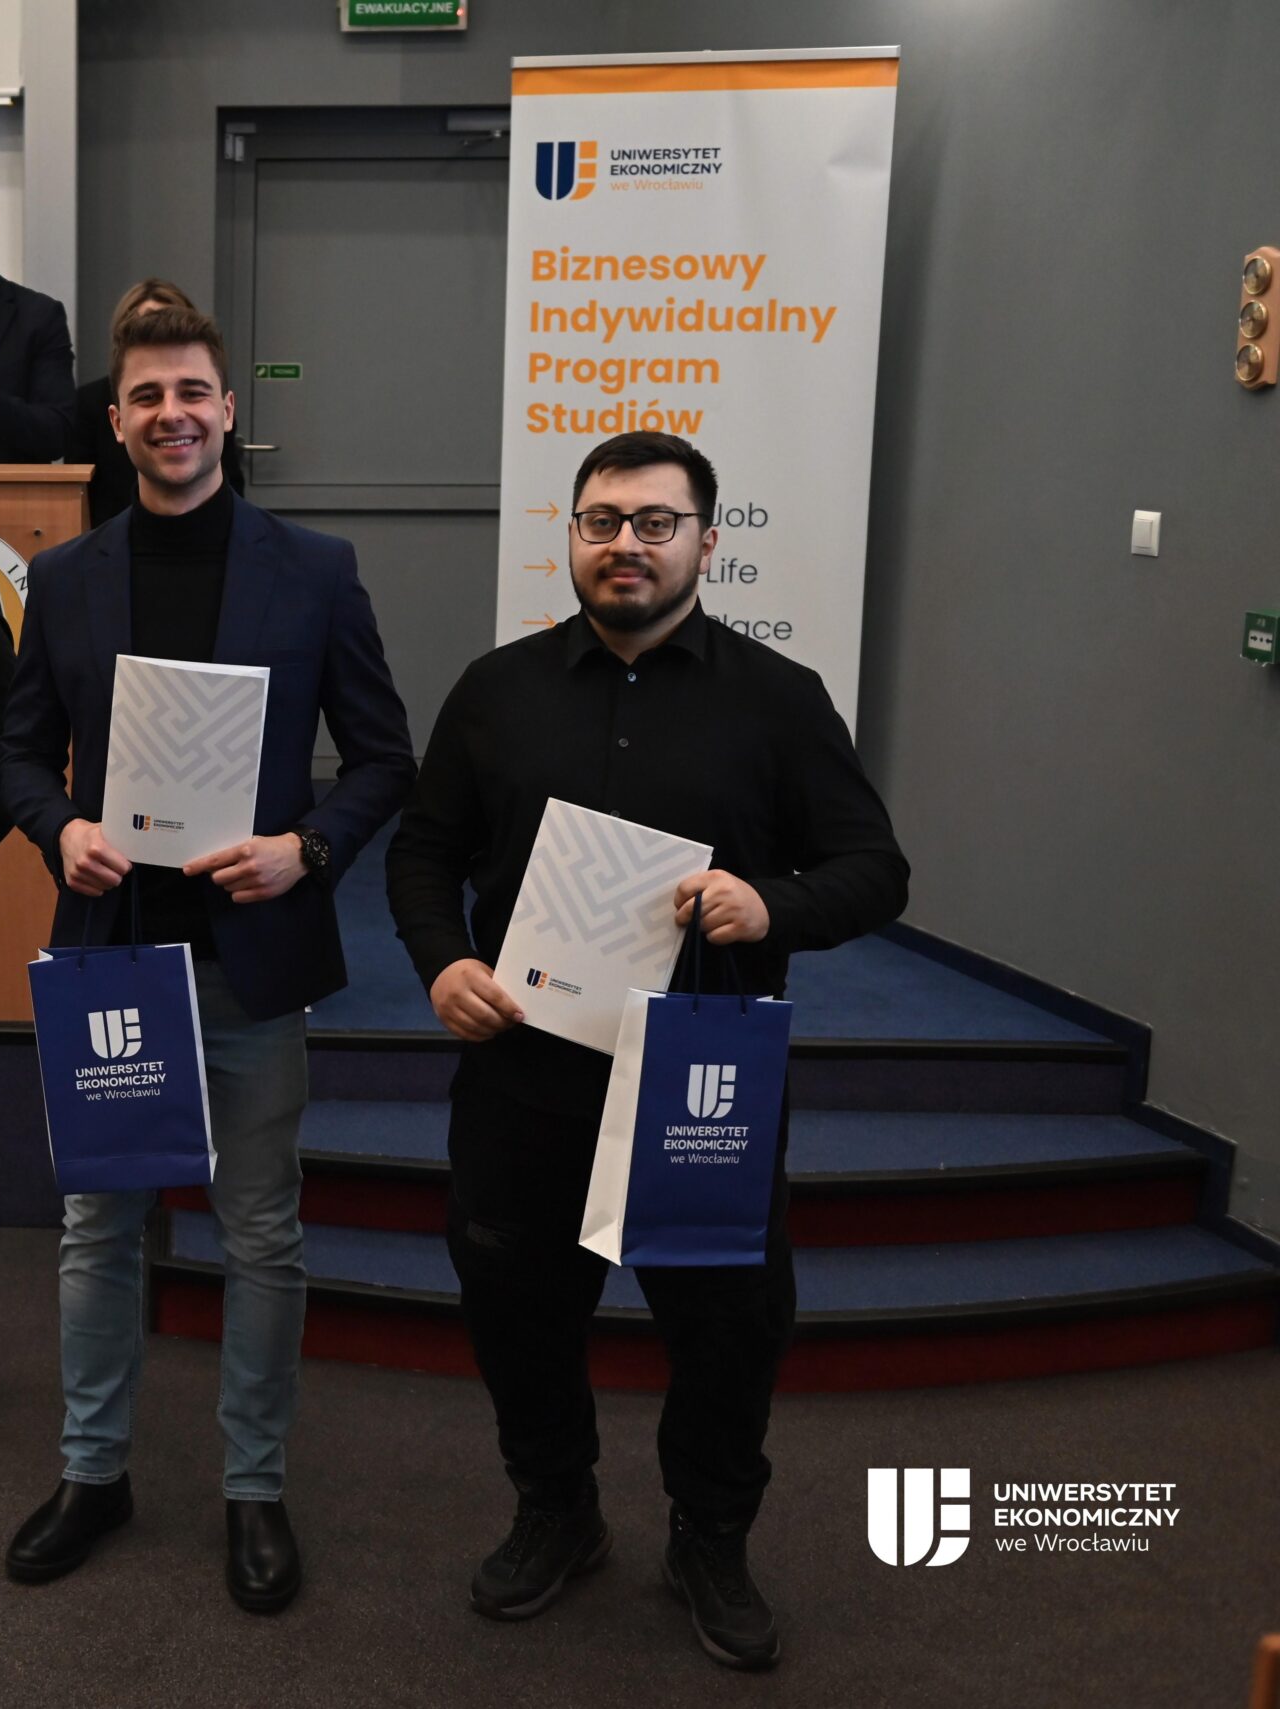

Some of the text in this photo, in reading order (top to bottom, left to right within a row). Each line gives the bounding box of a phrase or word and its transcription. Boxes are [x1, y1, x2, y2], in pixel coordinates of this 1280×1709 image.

[354, 2, 454, 15] EWAKUACYJNE
[610, 147, 721, 161] UNIWERSYTET
[609, 162, 723, 176] EKONOMICZNY
[610, 178, 704, 192] we Wrocławiu
[531, 246, 767, 292] Biznesowy
[529, 297, 837, 344] Indywidualny
[528, 352, 720, 395] Program
[526, 400, 704, 434] Studiów
[712, 502, 769, 528] Job
[706, 557, 758, 584] Life
[75, 1061, 164, 1078] UNIWERSYTET
[76, 1073, 167, 1090] EKONOMICZNY
[86, 1086, 161, 1101] we Wrocławiu
[666, 1126, 749, 1137] UNIWERSYTET
[663, 1139, 749, 1151] EKONOMICZNY
[670, 1153, 740, 1164] we Wrocławiu
